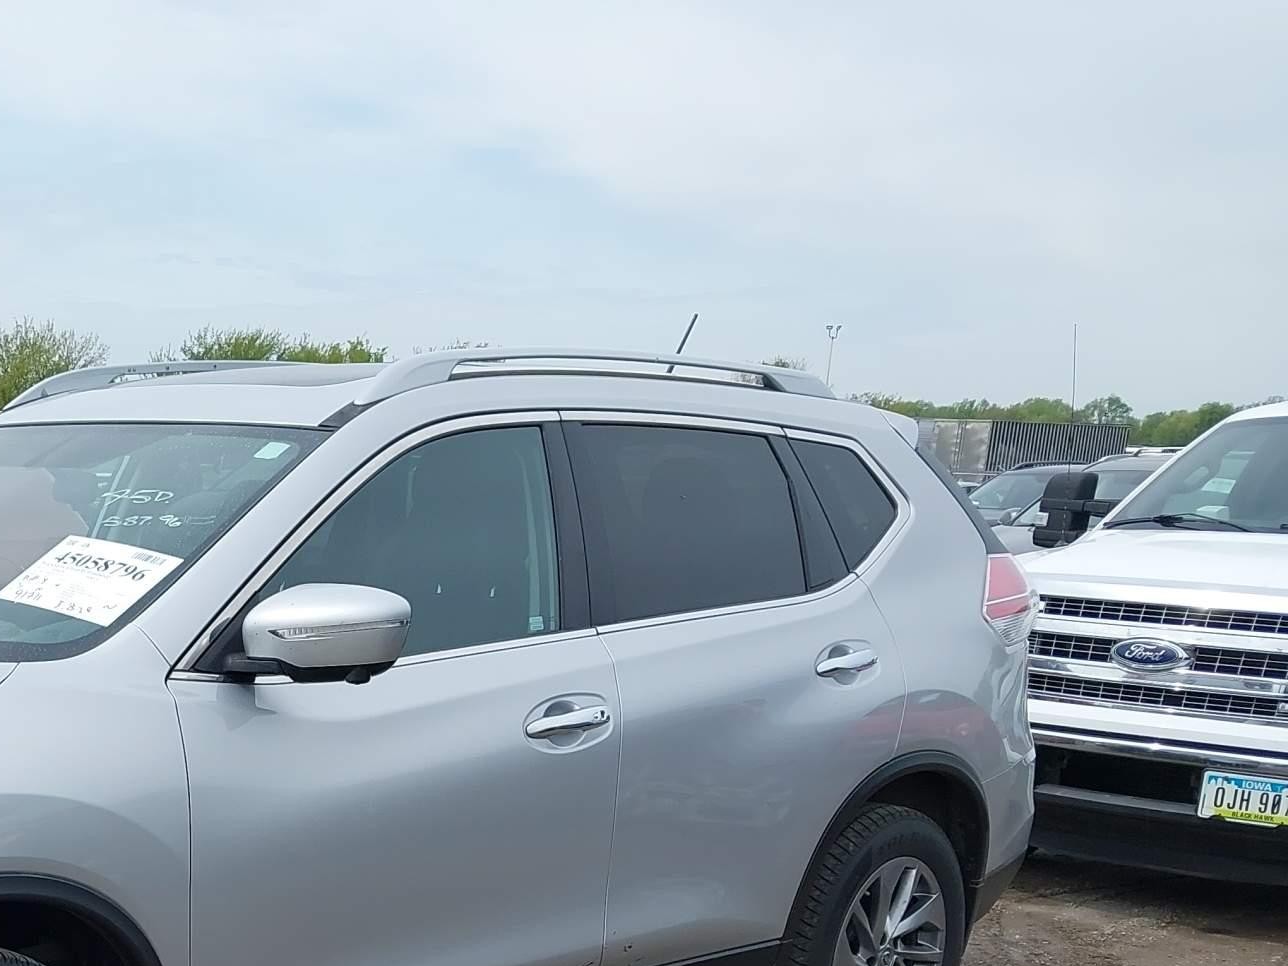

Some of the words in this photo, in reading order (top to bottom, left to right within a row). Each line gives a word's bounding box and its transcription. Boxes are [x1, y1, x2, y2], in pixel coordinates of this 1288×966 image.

[55, 551, 151, 581] 45058796
[1124, 643, 1166, 661] Ford
[1242, 780, 1273, 792] IOWA
[1231, 811, 1252, 820] BLACK
[1254, 814, 1274, 822] HAWK
